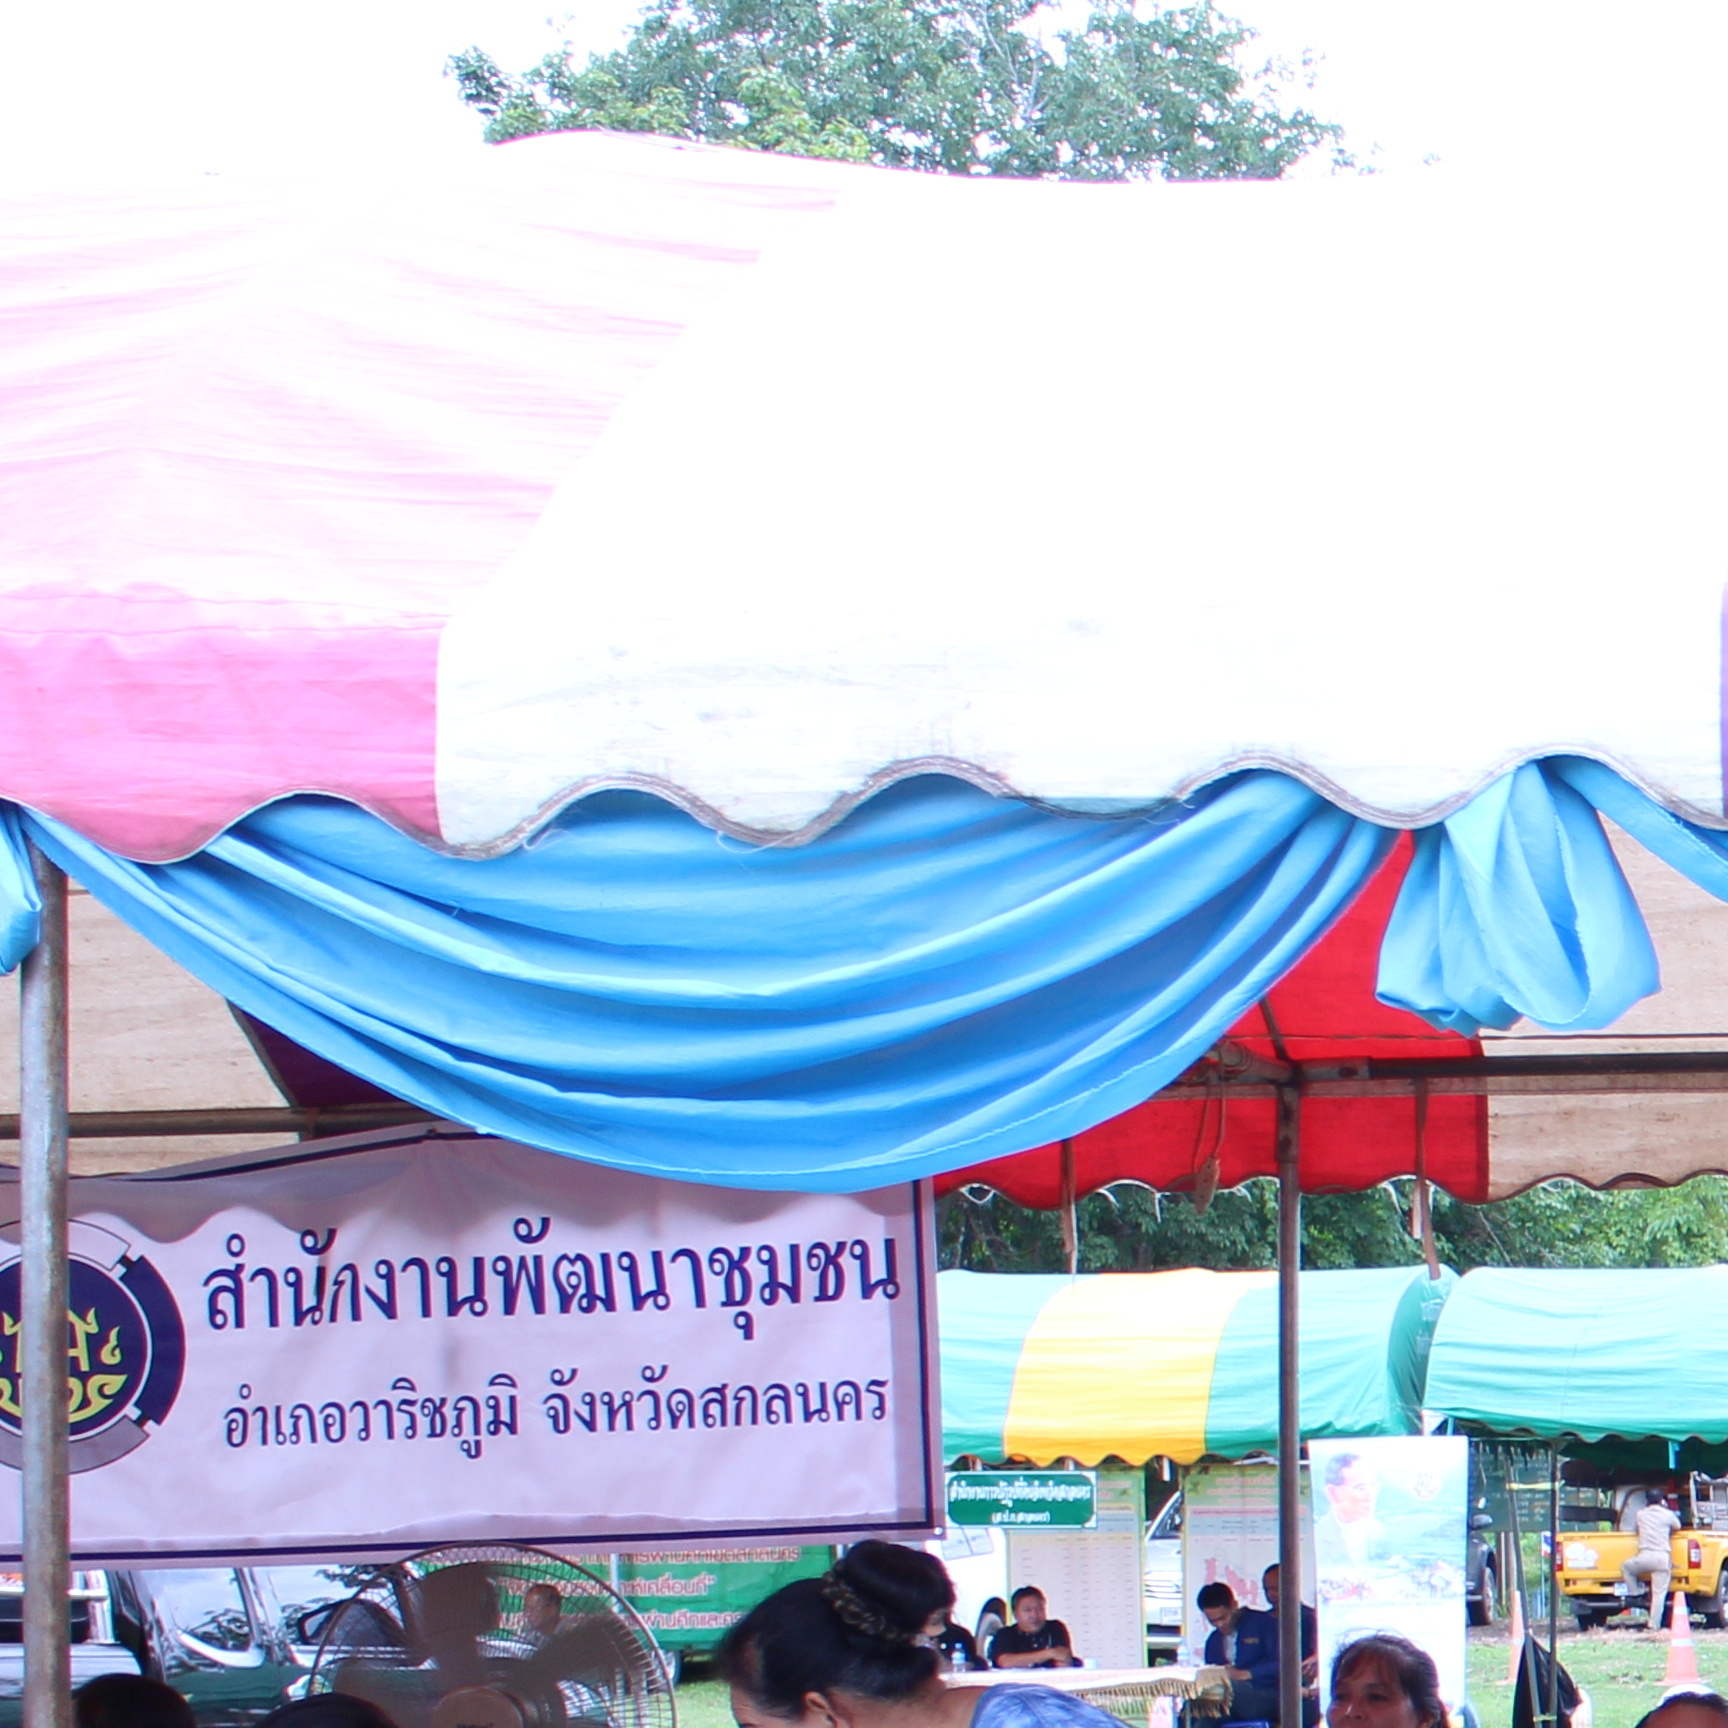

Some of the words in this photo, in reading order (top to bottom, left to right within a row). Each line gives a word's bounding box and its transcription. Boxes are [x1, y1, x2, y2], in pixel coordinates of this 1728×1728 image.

[202, 1216, 901, 1341] สำนักงานพัฒนาชุมชน
[223, 1373, 520, 1460] อำเภอวาริชภูมิ
[541, 1364, 891, 1436] จังหวัดสกลนคร
